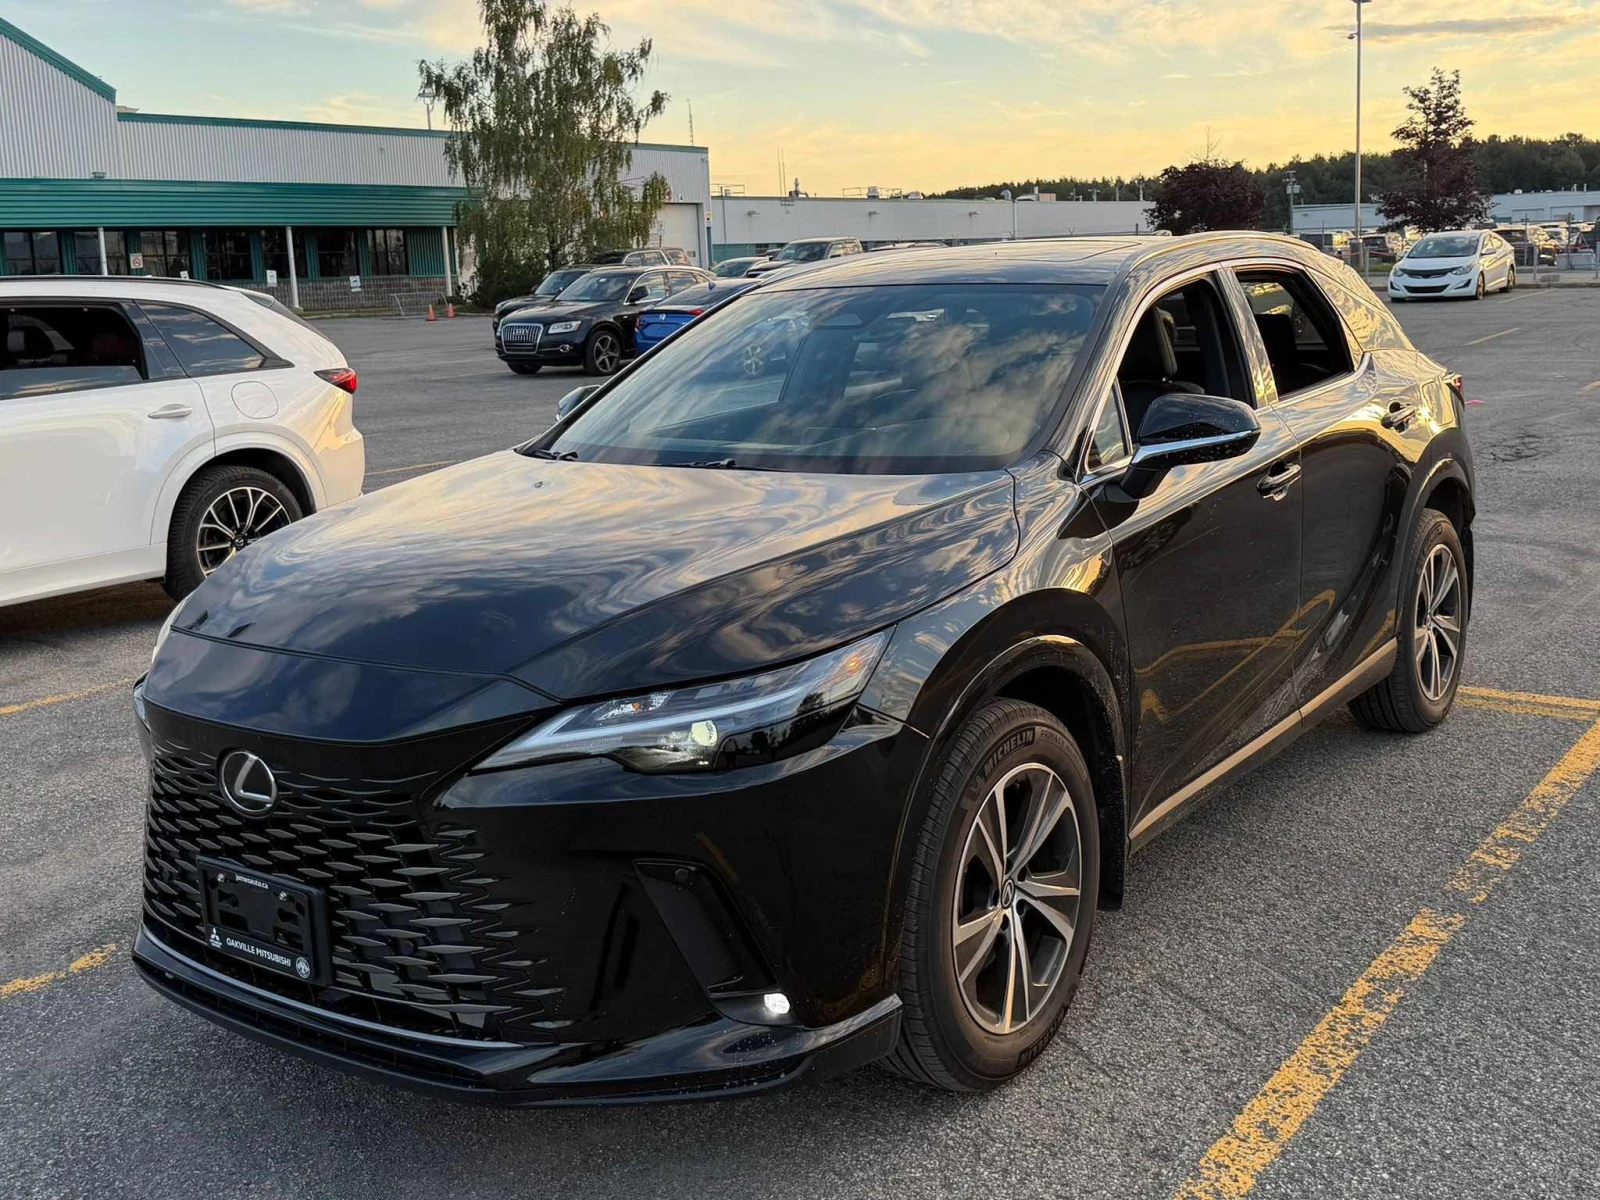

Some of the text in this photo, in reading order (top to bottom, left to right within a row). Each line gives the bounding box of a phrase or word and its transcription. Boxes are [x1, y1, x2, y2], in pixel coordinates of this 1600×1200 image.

[983, 729, 1034, 777] MICHELIN
[226, 937, 255, 955] OAKVILLE
[256, 948, 291, 967] MITSUBISHI
